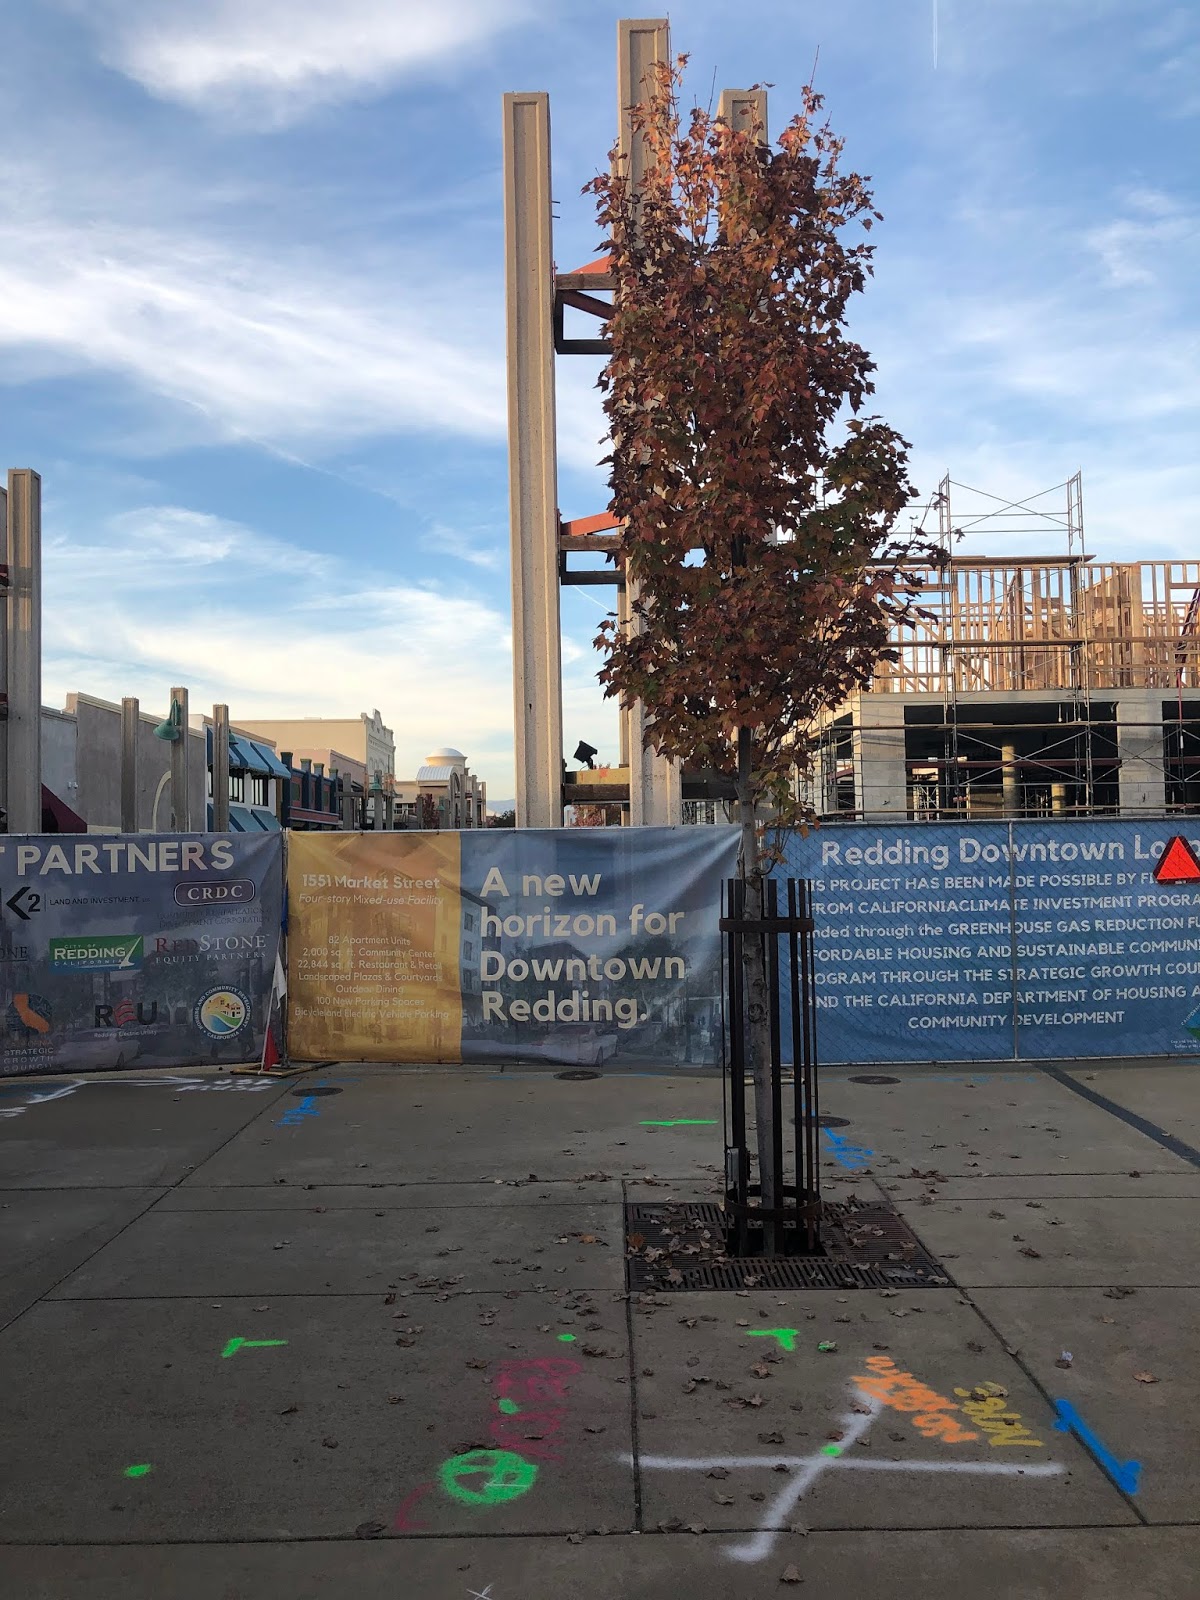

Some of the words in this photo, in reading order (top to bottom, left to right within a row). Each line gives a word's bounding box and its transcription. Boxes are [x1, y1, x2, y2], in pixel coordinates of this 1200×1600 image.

[17, 840, 234, 875] PARTNERS
[822, 838, 949, 871] Redding
[959, 837, 1124, 863] Downtown
[302, 873, 331, 888] 1551
[335, 875, 388, 889] Market
[393, 876, 440, 889] Street
[480, 867, 510, 897] A
[522, 873, 601, 897] new
[830, 878, 901, 891] PROJECT
[905, 877, 940, 890] HAS
[944, 876, 985, 889] BEEN
[988, 874, 1035, 888] MADE
[1040, 873, 1112, 887] POSSIBLE
[1116, 872, 1137, 886] BY
[187, 885, 243, 900] CRDC
[299, 893, 351, 905] Four-story
[353, 894, 404, 905] Mixed-use
[408, 895, 444, 906] Facility
[50, 898, 70, 906] LAND
[1033, 896, 1133, 910] INVESTMENT
[480, 906, 617, 937] horizon
[628, 904, 685, 935] for
[854, 924, 914, 939] through
[918, 923, 943, 936] the
[948, 921, 1052, 935] GREENHOUSE
[1057, 920, 1091, 933] GAS
[1094, 917, 1184, 932] REDUCTION
[328, 935, 340, 944] 82
[342, 935, 390, 946] Apartment
[391, 936, 411, 945] Units
[54, 946, 127, 961] REDDING
[303, 947, 329, 957] 2,000
[358, 947, 407, 958] Community
[408, 949, 437, 958] Center
[897, 946, 972, 960] HOUSING
[977, 945, 1012, 958] AND
[1016, 942, 1124, 957] SUSTAINABLE
[54, 959, 122, 967] CALIFORNIA
[155, 955, 200, 965] EQUITY
[207, 952, 266, 961] PARTNERS
[297, 960, 329, 970] 22,844
[358, 960, 408, 969] Restaurant
[410, 960, 417, 969] &
[418, 961, 443, 970] Retail
[480, 950, 685, 982] Downtown
[298, 972, 351, 982] Landscaped
[353, 972, 383, 981] Plazas
[384, 972, 392, 981] &
[394, 972, 443, 982] Courtyards
[880, 970, 959, 983] THROUGH
[963, 969, 993, 982] THE
[997, 967, 1086, 981] STRATEGIC
[1090, 964, 1161, 978] GROWTH
[205, 985, 238, 996] COMMUNITY
[335, 984, 372, 993] Outdoor
[375, 984, 404, 995] Dining
[843, 995, 873, 1008] THE
[878, 992, 979, 1006] CALIFORNIA
[982, 989, 1088, 1005] DEPARTMENT
[1092, 988, 1112, 1001] OF
[1116, 985, 1187, 1000] HOUSING
[317, 996, 331, 1005] 100
[332, 997, 353, 1005] New
[355, 996, 390, 1007] Parking
[392, 997, 425, 1007] Spaces
[294, 1006, 325, 1017] Bicycle
[325, 1007, 342, 1017] and
[344, 1008, 376, 1018] Electric
[379, 1009, 412, 1019] Vehicle
[414, 1009, 449, 1020] Parking
[482, 990, 648, 1029] Redding.
[908, 1014, 1008, 1029] COMMUNITY
[1012, 1011, 1125, 1026] DEVELOPMENT
[4, 1047, 55, 1057] STRATEGIC
[3, 1055, 54, 1065] GROWTH
